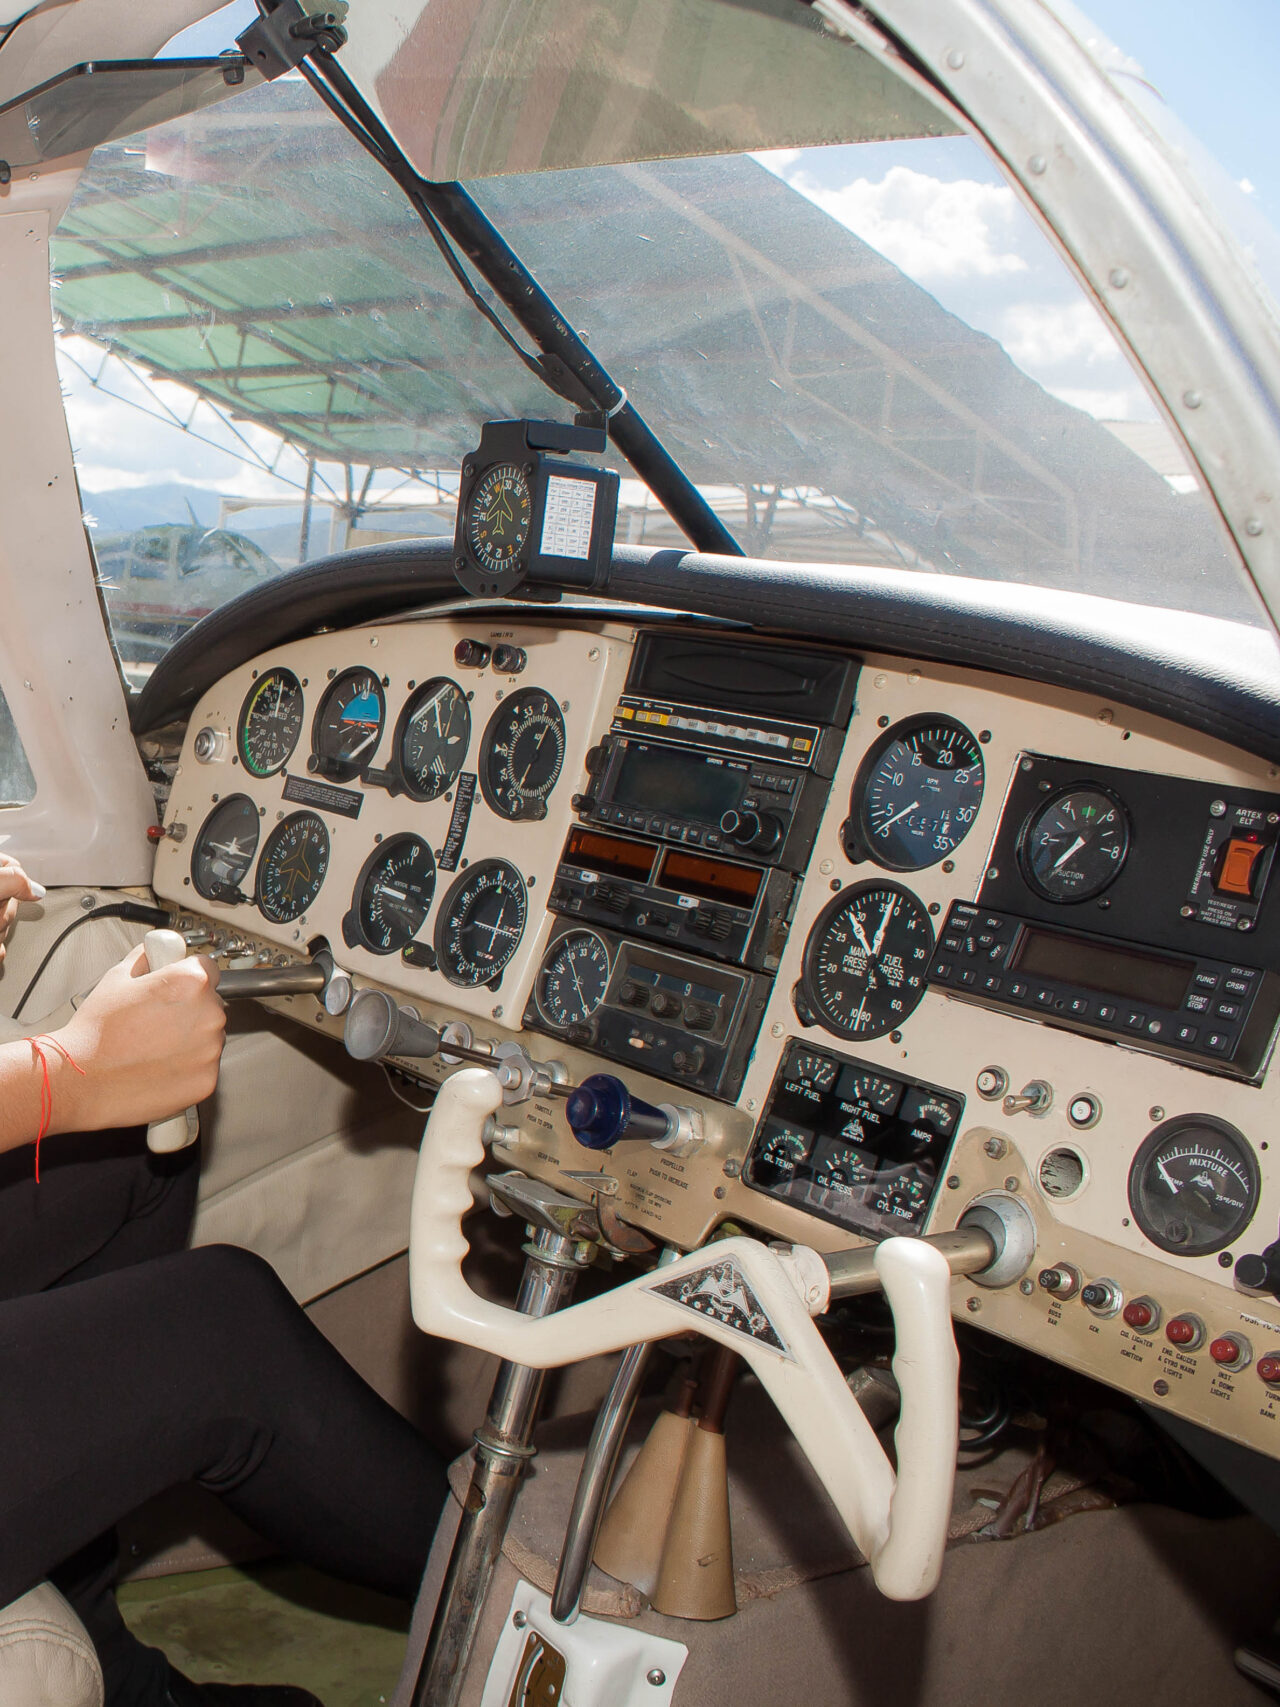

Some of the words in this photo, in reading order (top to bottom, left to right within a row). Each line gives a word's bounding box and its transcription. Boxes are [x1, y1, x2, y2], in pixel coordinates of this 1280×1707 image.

[504, 480, 512, 490] 30
[523, 706, 534, 719] 33
[421, 720, 428, 732] 8
[911, 753, 922, 766] 15
[937, 750, 952, 764] 20
[421, 765, 428, 778] 6
[954, 769, 969, 783] 25
[434, 775, 441, 788] 5
[892, 773, 903, 786] 10
[886, 803, 894, 816] 5
[1062, 801, 1071, 813] 4
[956, 808, 972, 822] 30
[1107, 809, 1115, 821] 6
[1236, 809, 1262, 819] ARTEX
[1240, 817, 1254, 825] ELT
[881, 825, 889, 837] 3
[933, 836, 948, 849] 35
[1040, 833, 1049, 845] 2
[411, 846, 419, 857] 10
[1111, 846, 1119, 859] 8
[1191, 858, 1205, 894] EMERGENCY
[1206, 829, 1214, 845] ONLY
[497, 870, 504, 880] N
[1058, 870, 1084, 879] SUCTION
[477, 875, 487, 886] 33
[374, 884, 379, 895] 0
[879, 903, 888, 913] 35
[894, 907, 900, 916] 0
[370, 911, 377, 921] 5
[856, 912, 867, 922] 30
[451, 917, 459, 928] W
[382, 935, 390, 947] 10
[836, 932, 847, 942] 25
[979, 935, 991, 943] ALT
[914, 948, 925, 959] 30
[990, 946, 1002, 958] OFF
[883, 954, 903, 969] FUEL
[827, 964, 837, 974] 20
[938, 965, 944, 973] 0
[1231, 967, 1242, 975] GTX
[653, 973, 661, 987] 7
[908, 976, 919, 987] 45
[963, 972, 968, 980] 1
[1196, 974, 1216, 984] FUNC
[986, 978, 993, 986] 2
[1226, 981, 1245, 991] CRSR
[684, 983, 692, 996] 9
[1012, 985, 1020, 993] 3
[835, 991, 843, 1001] 15
[1038, 992, 1046, 1000] 4
[1189, 994, 1207, 1003] START
[1072, 1000, 1079, 1009] 5
[1187, 1001, 1204, 1010] STOP
[1219, 1005, 1233, 1014] CLR
[850, 1008, 858, 1018] 10
[860, 1011, 871, 1022] 80
[1100, 1008, 1108, 1016] 6
[1181, 1028, 1187, 1037] 8
[1210, 1036, 1217, 1044] 9
[785, 1082, 802, 1095] LEFT
[804, 1089, 821, 1103] FUEL
[840, 1102, 861, 1116] RIGHT
[861, 1110, 880, 1124] FUEL
[910, 1129, 932, 1142] AMPS
[764, 1153, 774, 1164] OIL
[661, 1158, 685, 1172] PROPELLER
[1189, 1158, 1229, 1178] MIXTURE
[817, 1175, 829, 1186] OIL
[1084, 1290, 1095, 1299] 50
[1132, 1335, 1153, 1348] LIGHTER
[1120, 1350, 1143, 1362] IGNITION
[1176, 1354, 1197, 1366] GAUGES
[1164, 1358, 1178, 1367] GYRO
[1180, 1365, 1195, 1375] WARN
[1163, 1367, 1182, 1379] LIGHTS
[1219, 1382, 1235, 1392] DOME
[1210, 1388, 1231, 1400] LIGHTS
[1260, 1409, 1276, 1420] BANK
